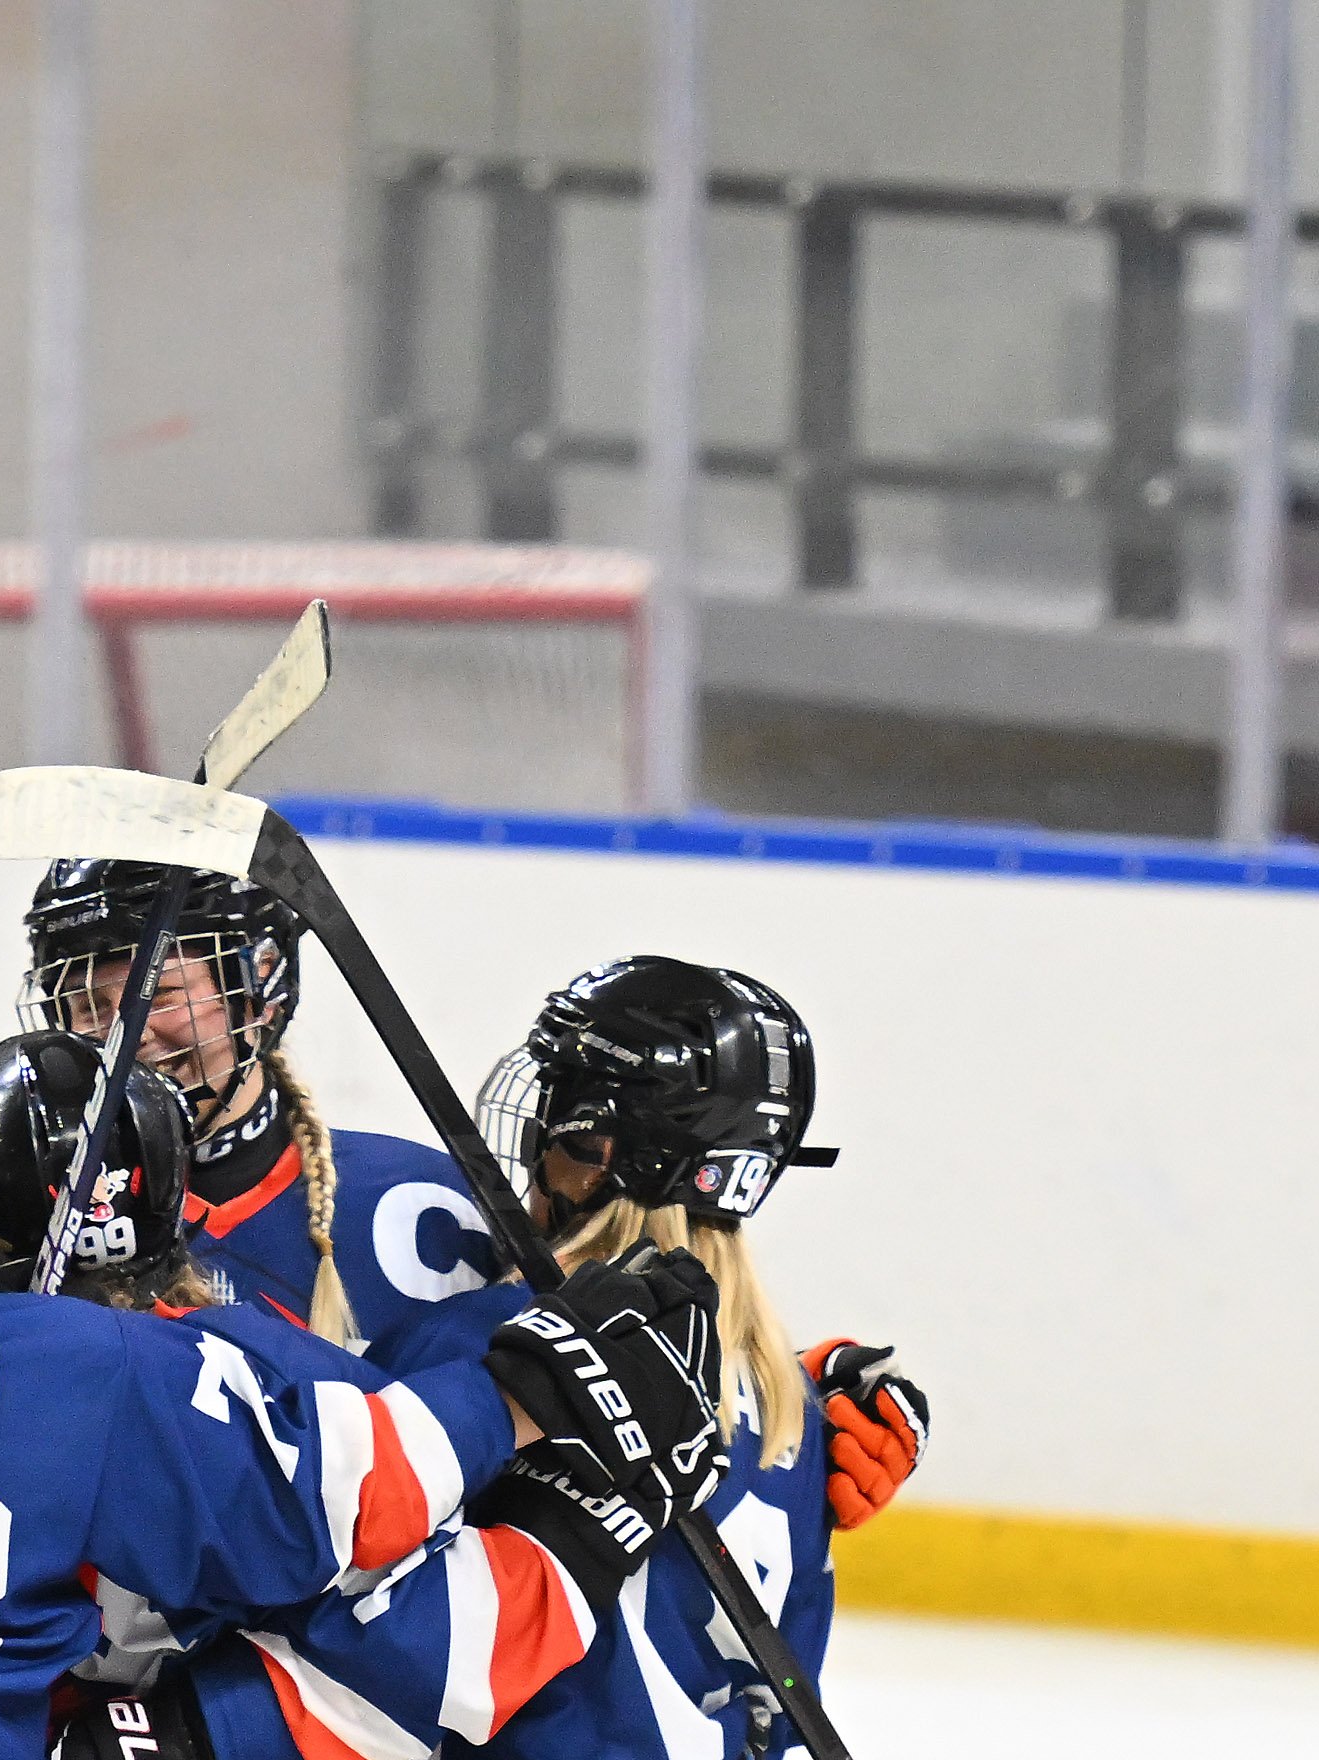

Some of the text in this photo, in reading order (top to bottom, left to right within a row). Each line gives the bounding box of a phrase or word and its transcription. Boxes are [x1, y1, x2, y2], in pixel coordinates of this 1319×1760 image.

[717, 1154, 770, 1213] 19
[75, 1215, 137, 1271] 99
[504, 1307, 653, 1463] BAUE
